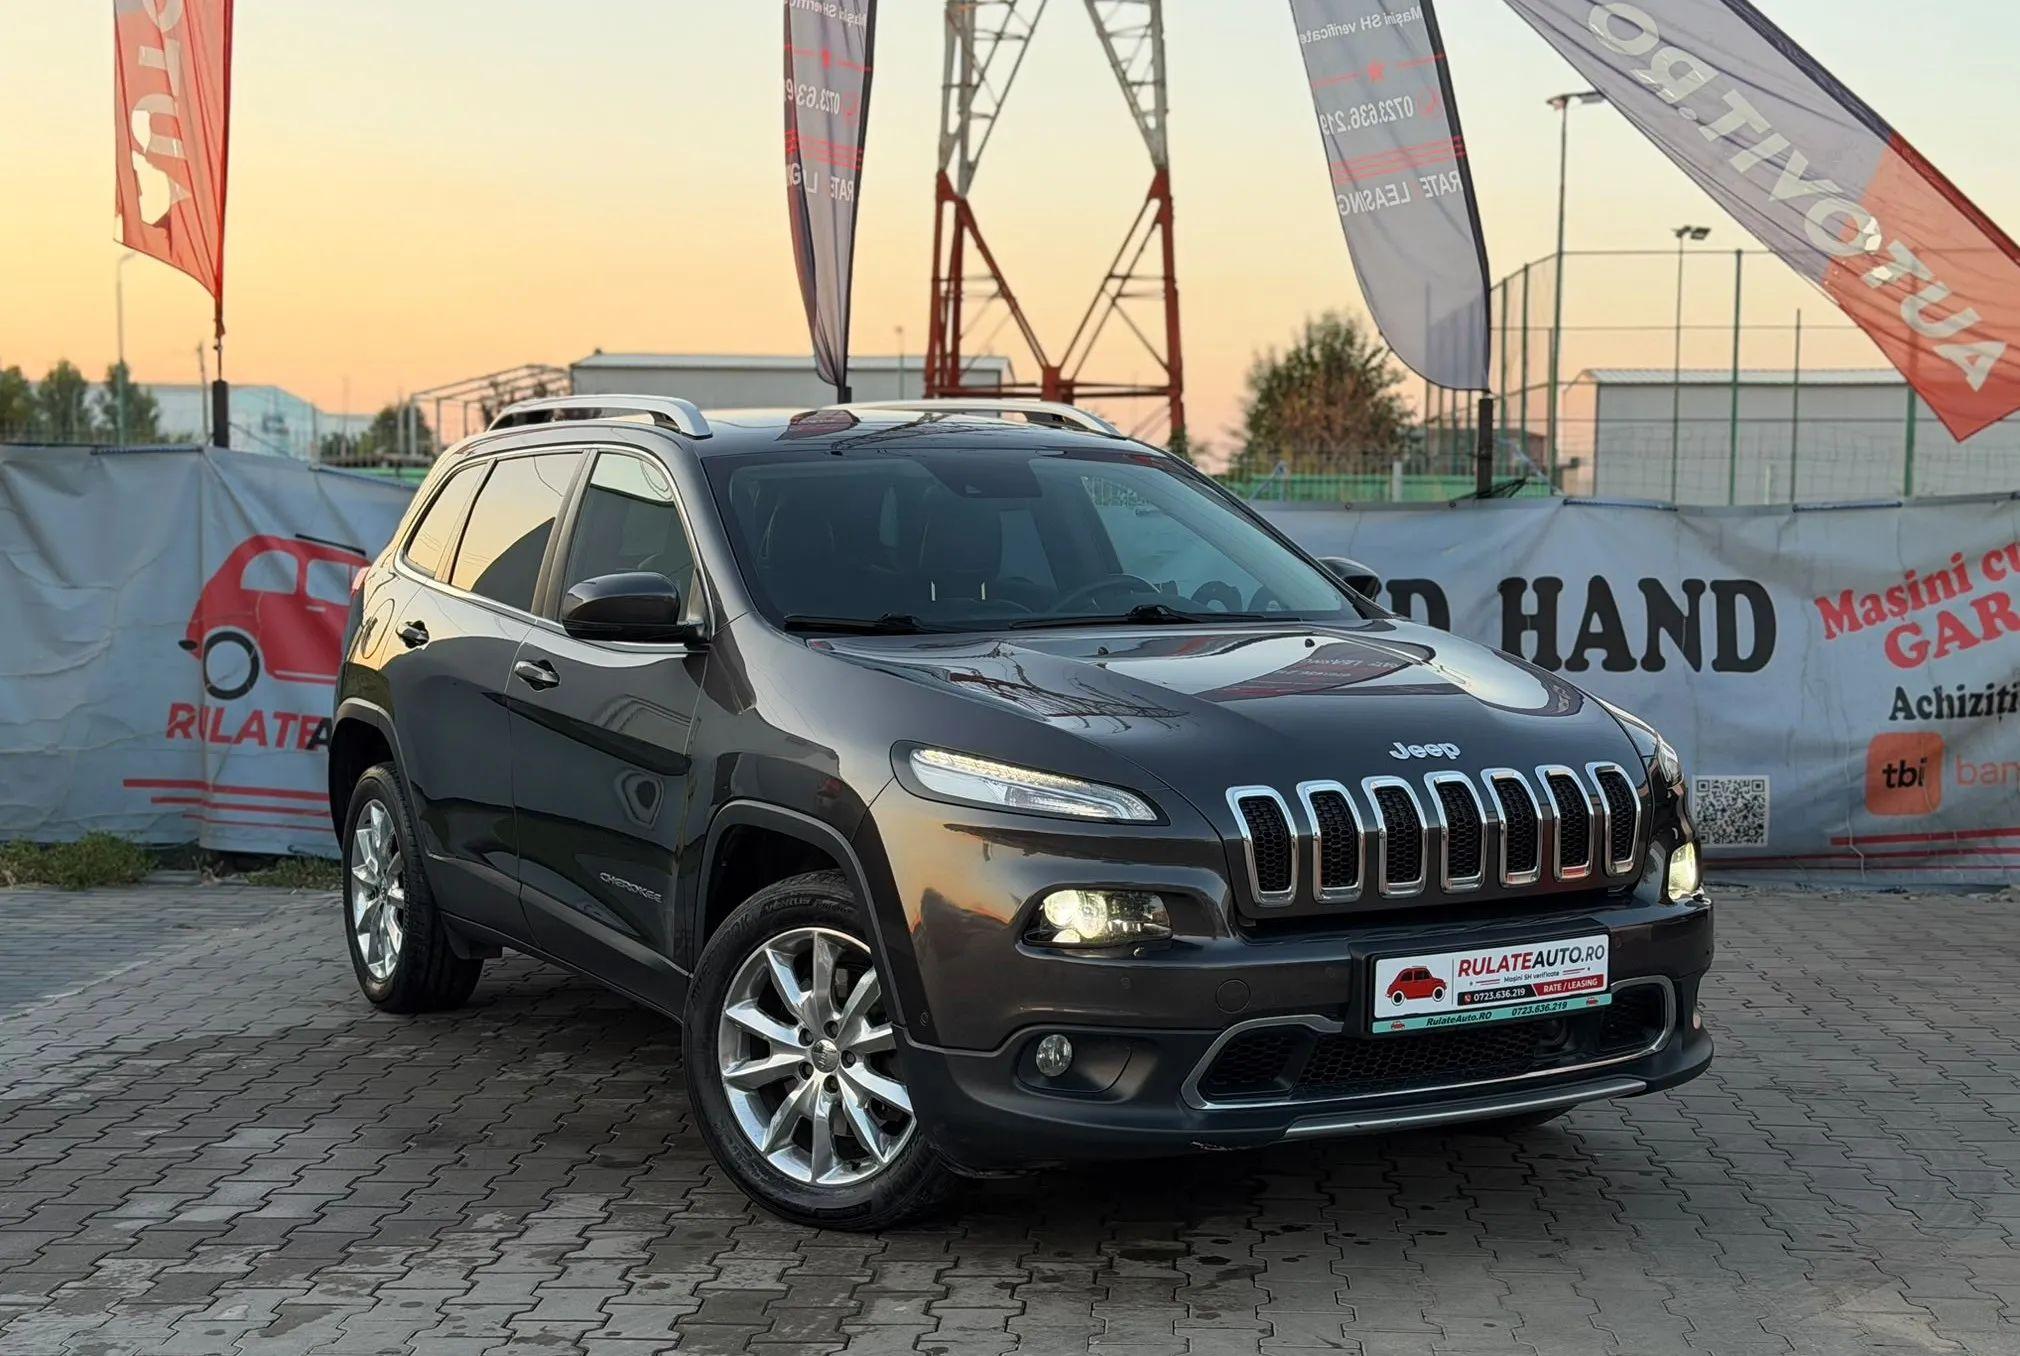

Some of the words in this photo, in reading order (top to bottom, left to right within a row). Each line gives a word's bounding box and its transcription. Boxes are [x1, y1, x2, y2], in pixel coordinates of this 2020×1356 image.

[1497, 574, 1778, 673] HAND
[1389, 742, 1461, 760] Jeep
[1882, 757, 1928, 789] tbi
[1458, 944, 1605, 977] RULATEAUTO.RO
[1543, 982, 1562, 993] RATE
[1567, 978, 1598, 990] LEASING
[1473, 988, 1526, 1002] 0723.636.219
[1511, 1001, 1568, 1016] 0723.636.219
[1426, 1011, 1493, 1026] RulateAuto.RO
